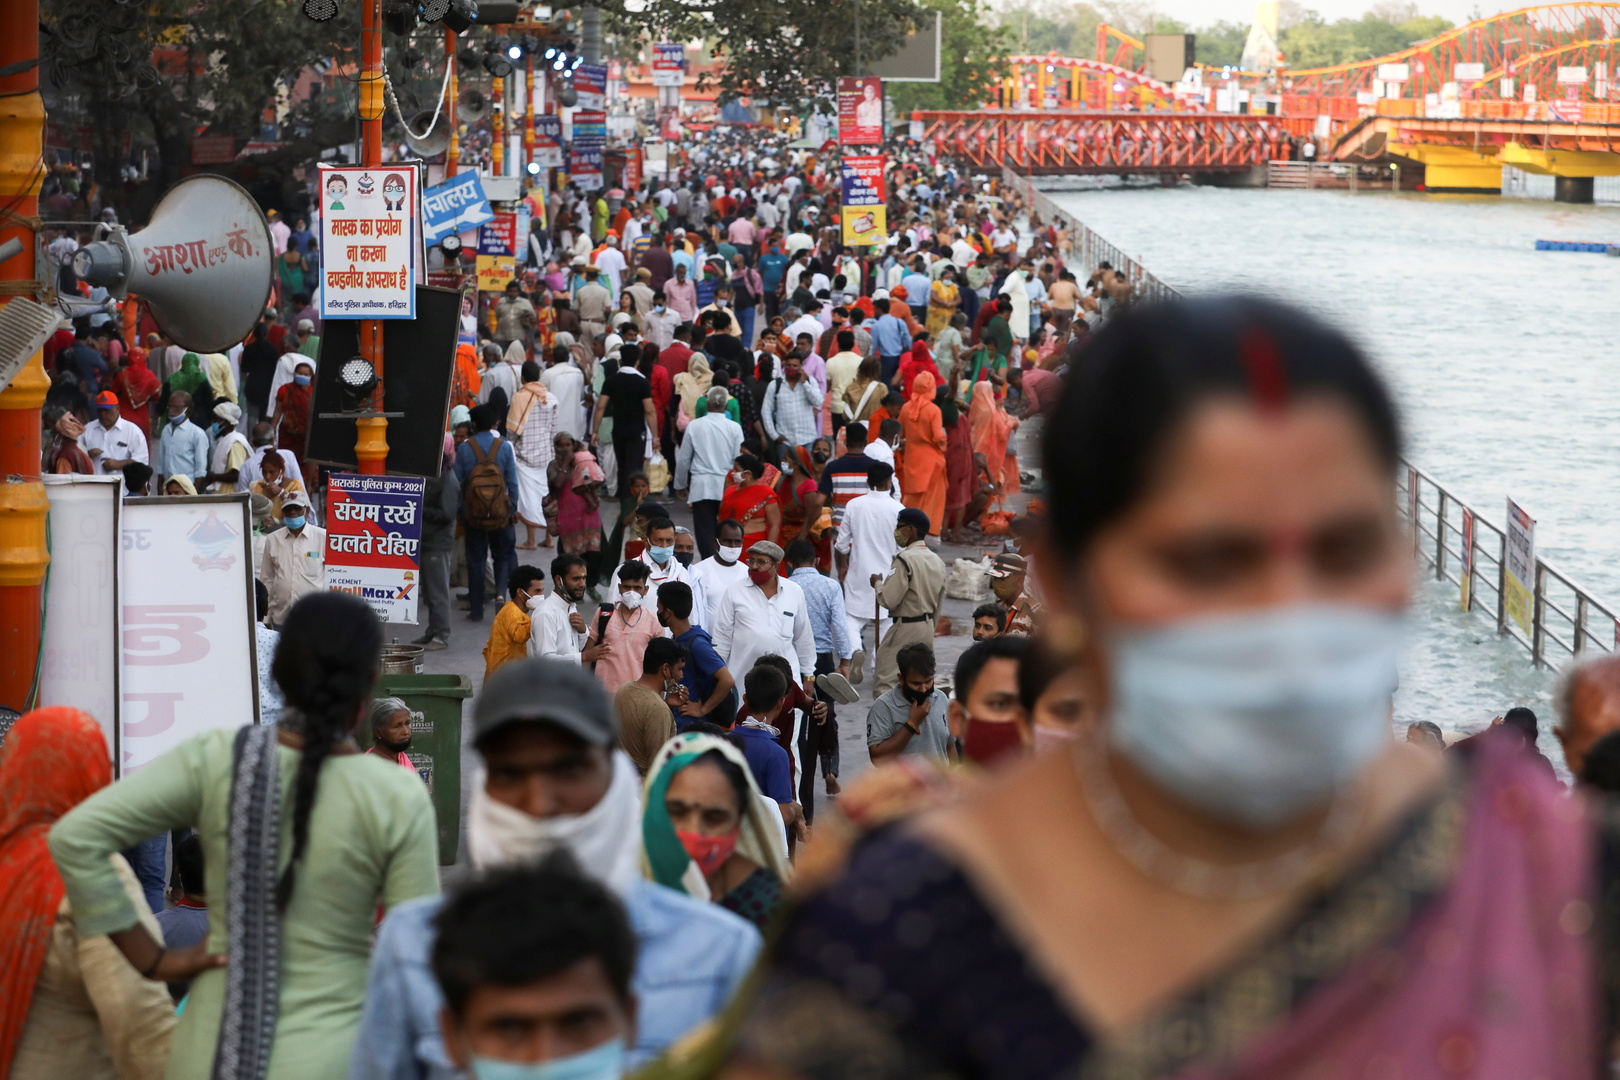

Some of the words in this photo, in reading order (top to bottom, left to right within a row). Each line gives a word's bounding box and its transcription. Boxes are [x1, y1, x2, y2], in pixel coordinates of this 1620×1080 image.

[331, 218, 358, 236] मास्क
[360, 218, 373, 236] का
[376, 212, 402, 240] प्रयोग
[143, 239, 208, 276] आशा
[346, 245, 358, 262] ना
[360, 245, 387, 262] करना
[327, 264, 364, 290] दण्डनीय
[366, 271, 397, 290] अपराध
[399, 264, 408, 291] है
[344, 300, 361, 311] पुलिस
[388, 300, 407, 310] हरिद्वार
[361, 479, 383, 492] पुलिस
[334, 498, 380, 523] संयम
[383, 500, 417, 525] रखें
[329, 530, 373, 554] चलते
[376, 532, 419, 557] रहिए
